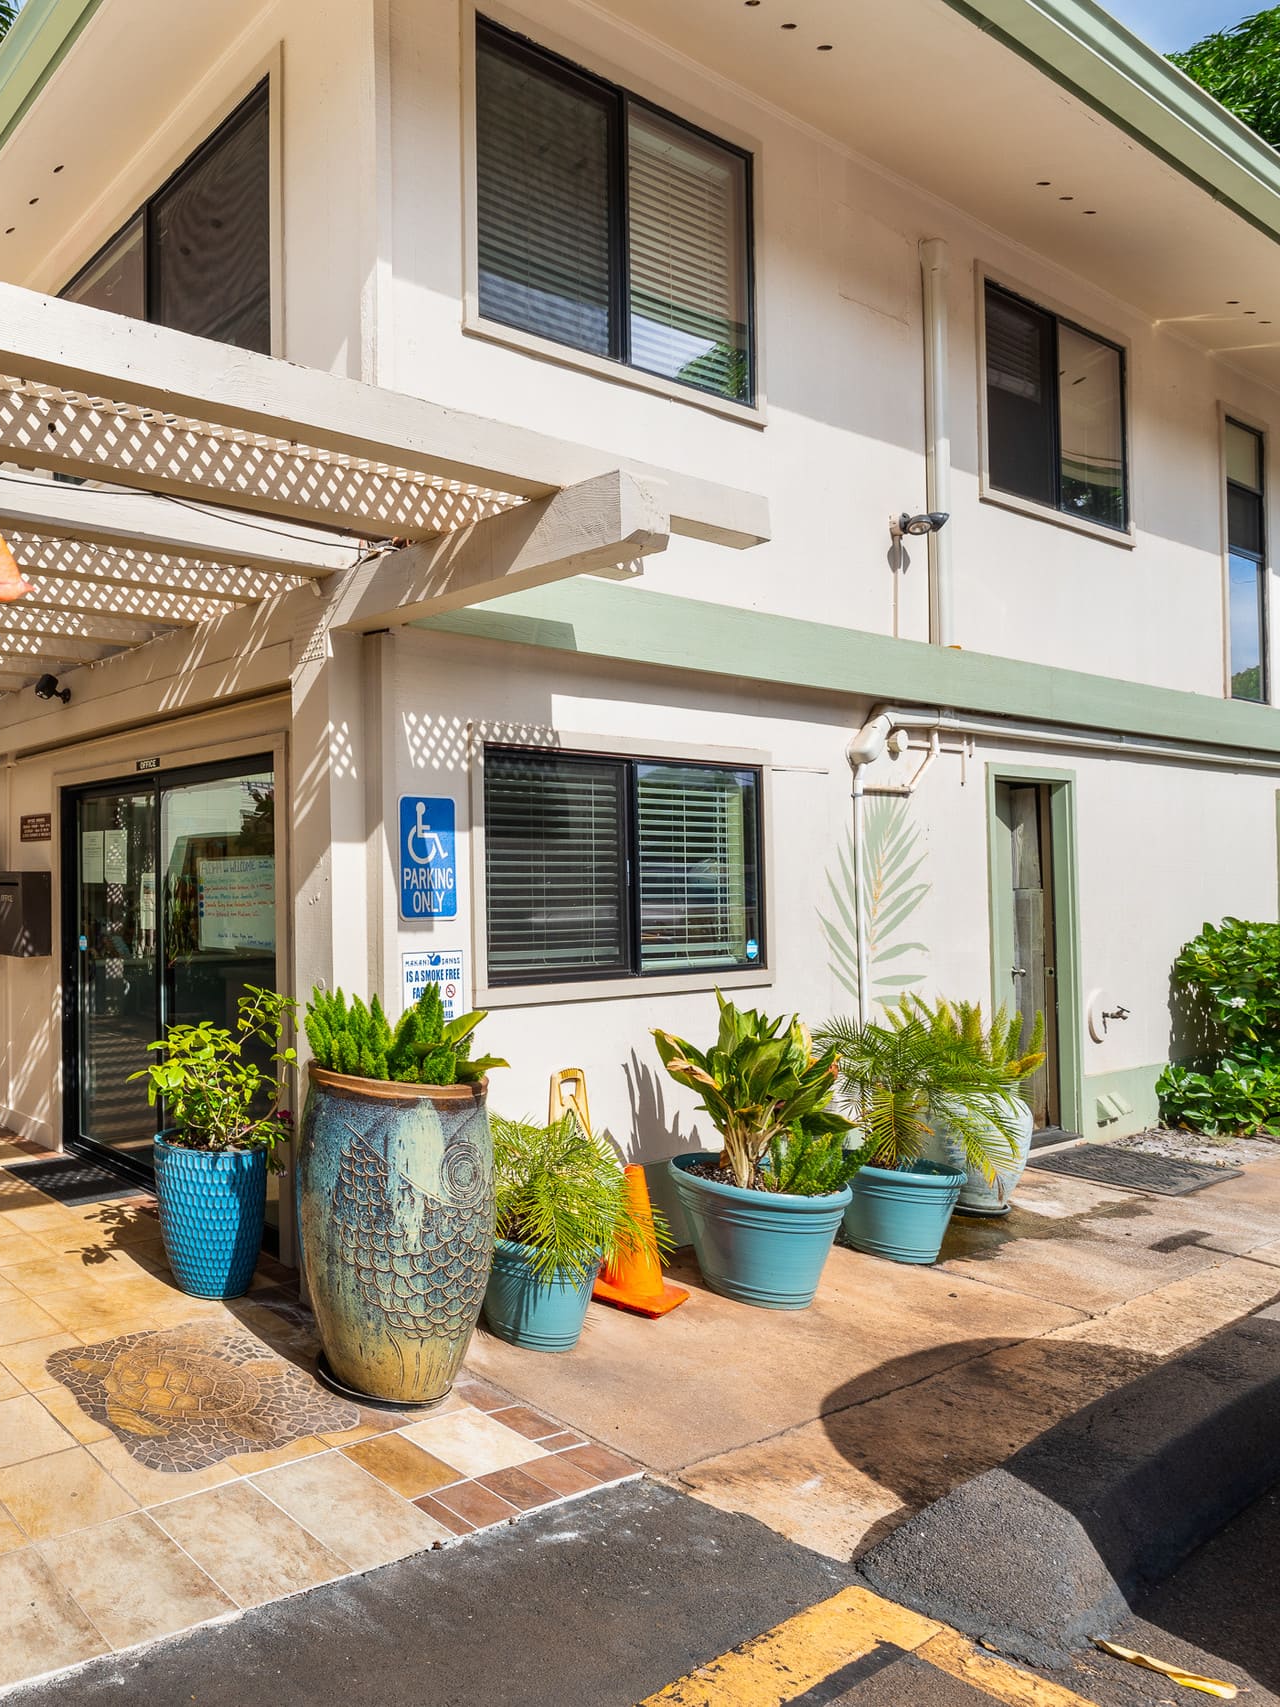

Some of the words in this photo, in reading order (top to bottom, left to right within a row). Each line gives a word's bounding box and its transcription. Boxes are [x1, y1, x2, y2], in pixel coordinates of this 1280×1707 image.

[140, 759, 157, 770] OFFICE
[403, 867, 454, 890] PARKING
[413, 891, 445, 913] ONLY
[406, 970, 414, 983] IS
[415, 970, 420, 982] A
[421, 969, 444, 982] SMOKE
[446, 968, 461, 980] FREE
